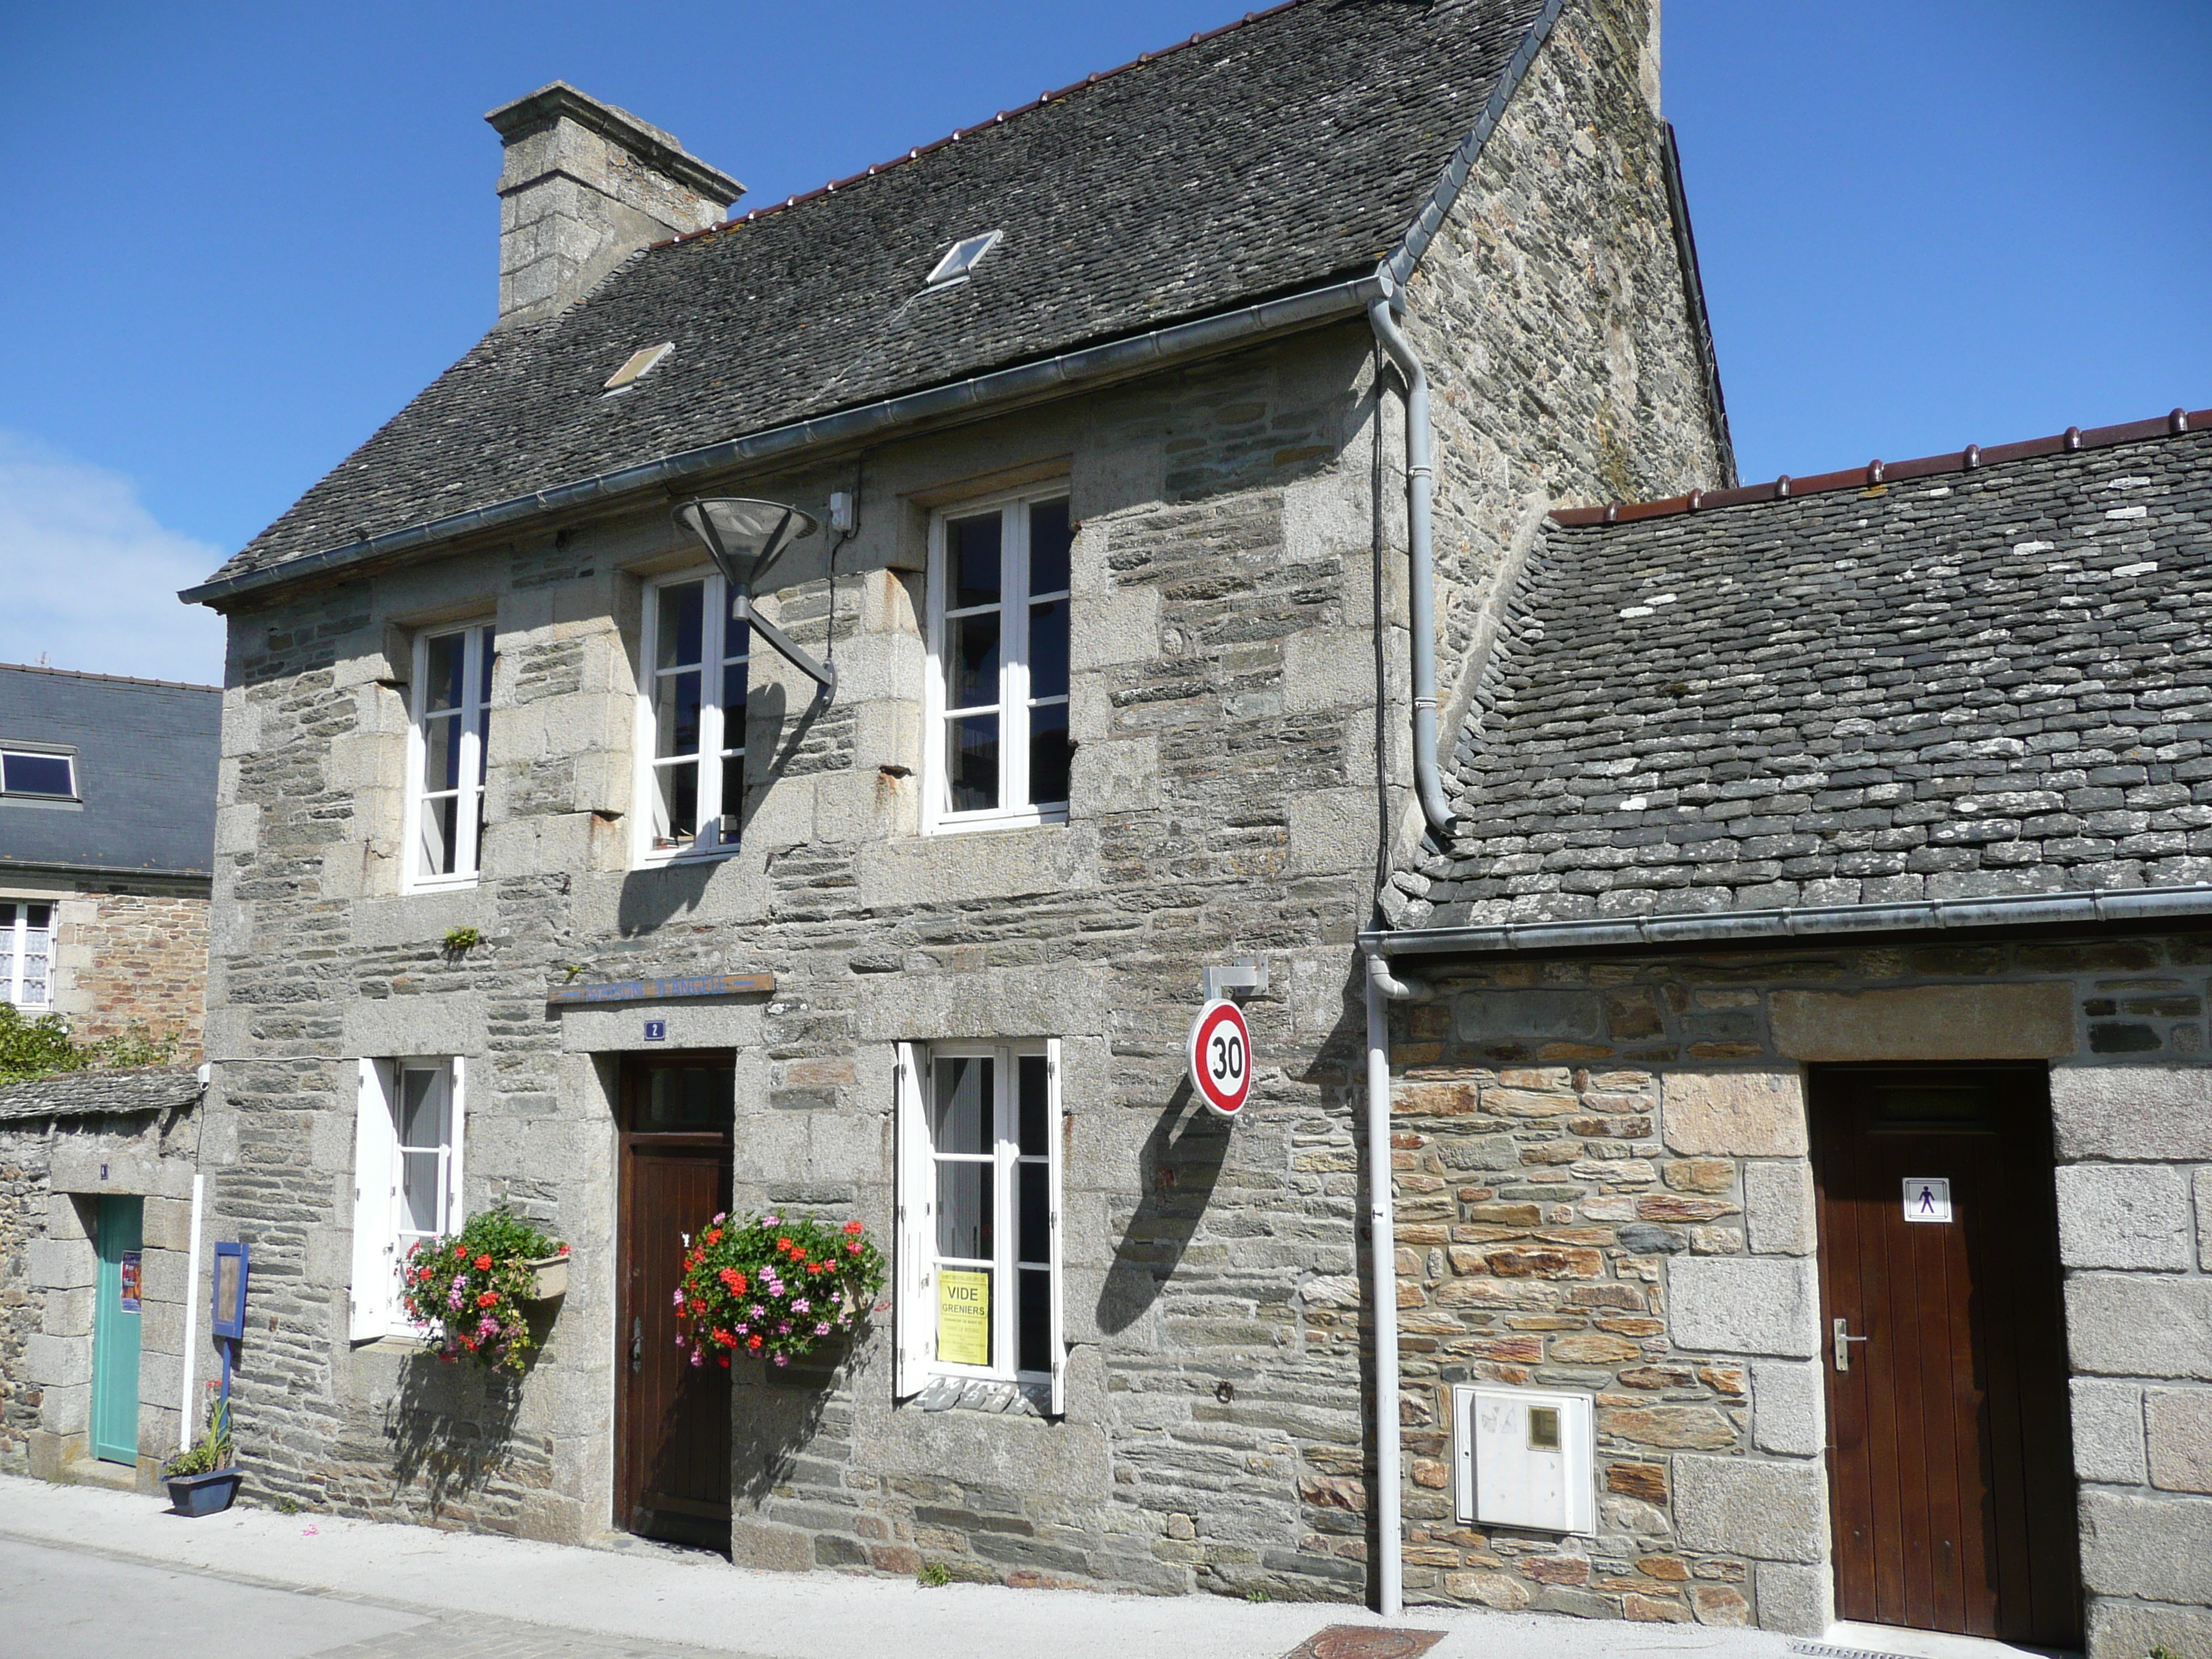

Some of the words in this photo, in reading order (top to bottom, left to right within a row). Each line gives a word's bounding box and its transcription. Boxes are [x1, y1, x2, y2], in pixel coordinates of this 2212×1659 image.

[652, 1023, 657, 1036] 2
[1213, 1037, 1242, 1079] 30
[947, 1285, 979, 1301] VIDE
[942, 1303, 985, 1316] GRENIERS
